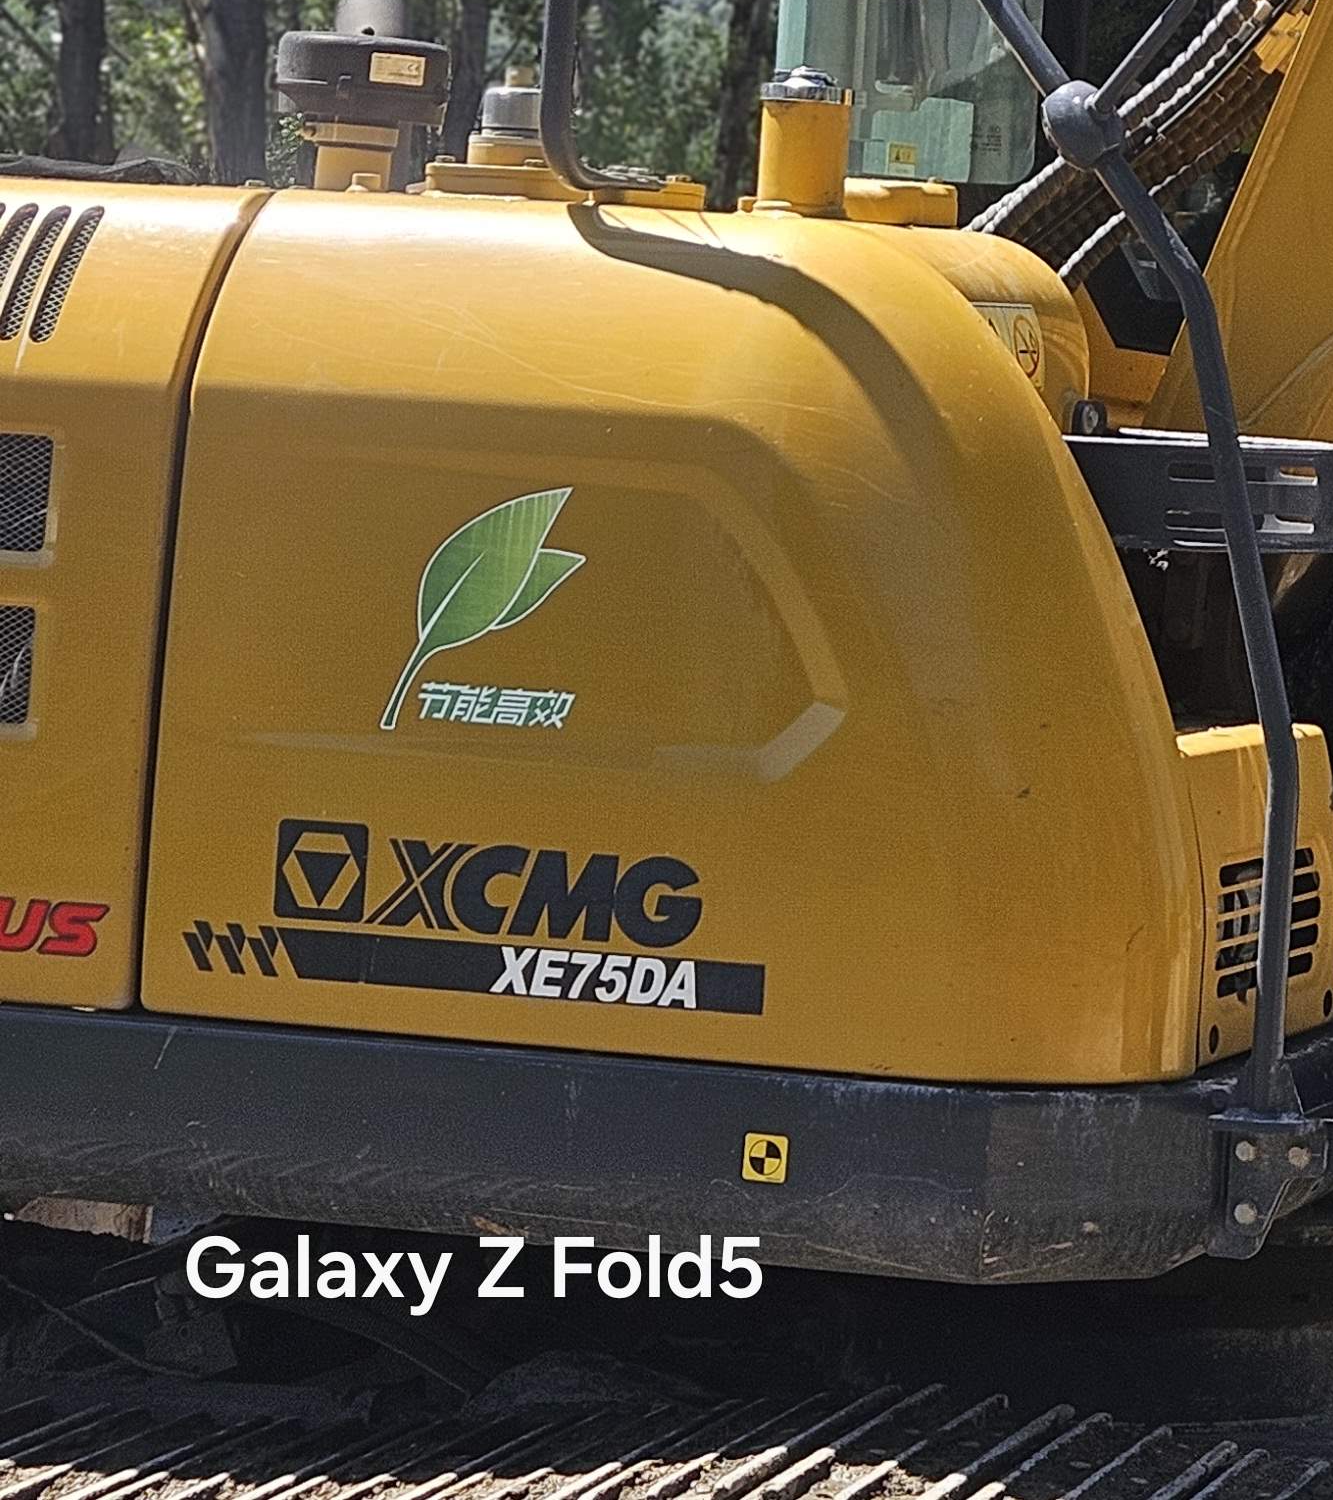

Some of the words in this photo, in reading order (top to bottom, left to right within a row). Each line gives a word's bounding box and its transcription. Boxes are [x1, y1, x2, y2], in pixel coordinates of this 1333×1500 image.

[418, 681, 577, 730] 节能高效
[364, 838, 703, 949] XCMG
[488, 946, 699, 1010] XE75DA
